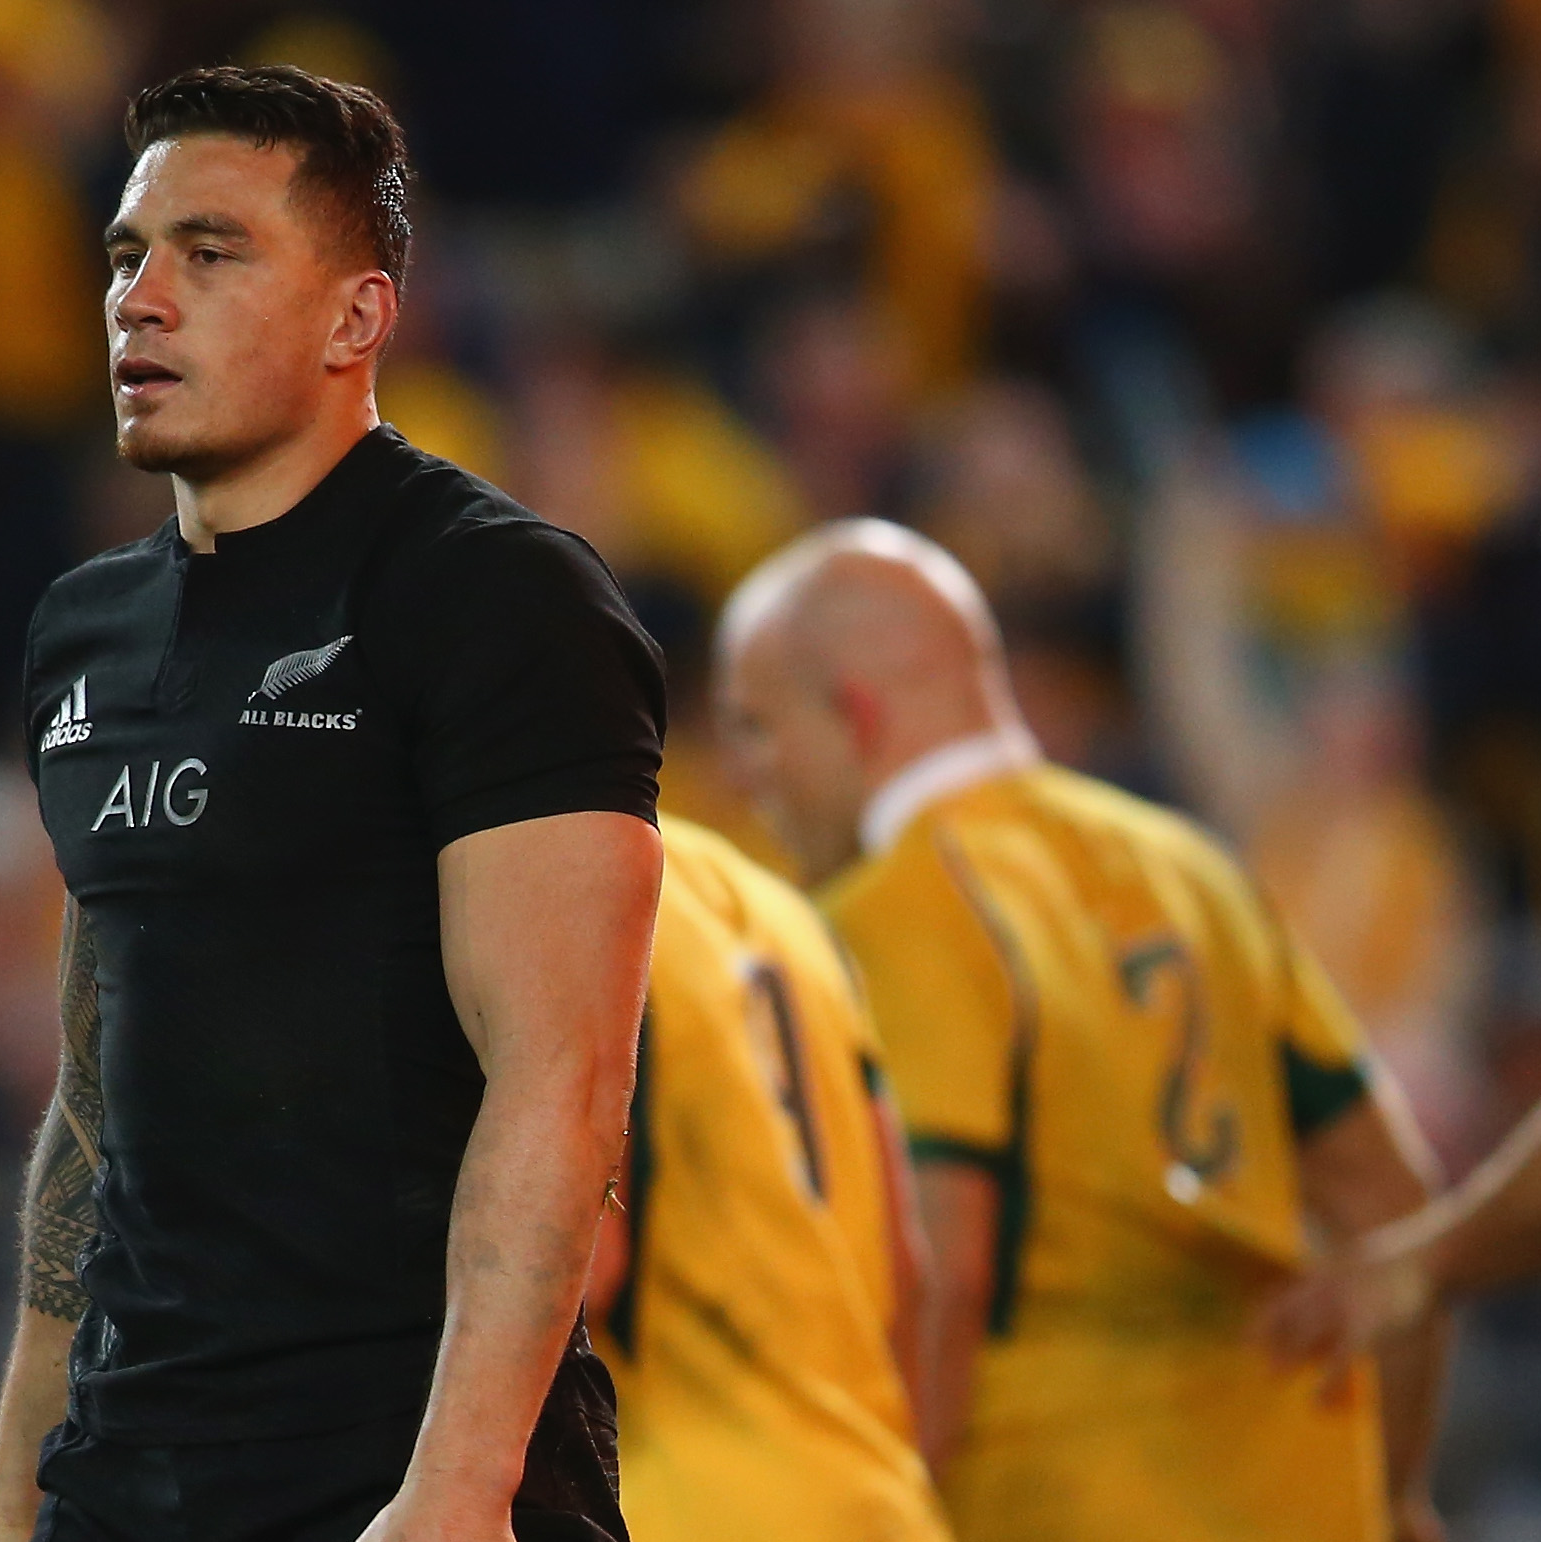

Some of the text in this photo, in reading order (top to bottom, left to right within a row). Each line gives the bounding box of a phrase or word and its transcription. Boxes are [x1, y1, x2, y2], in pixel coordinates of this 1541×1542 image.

[40, 721, 93, 753] adidas
[238, 709, 357, 730] ALL BLACKS
[90, 757, 209, 832] AIG
[733, 950, 832, 1212] 1
[1110, 928, 1246, 1206] 2
